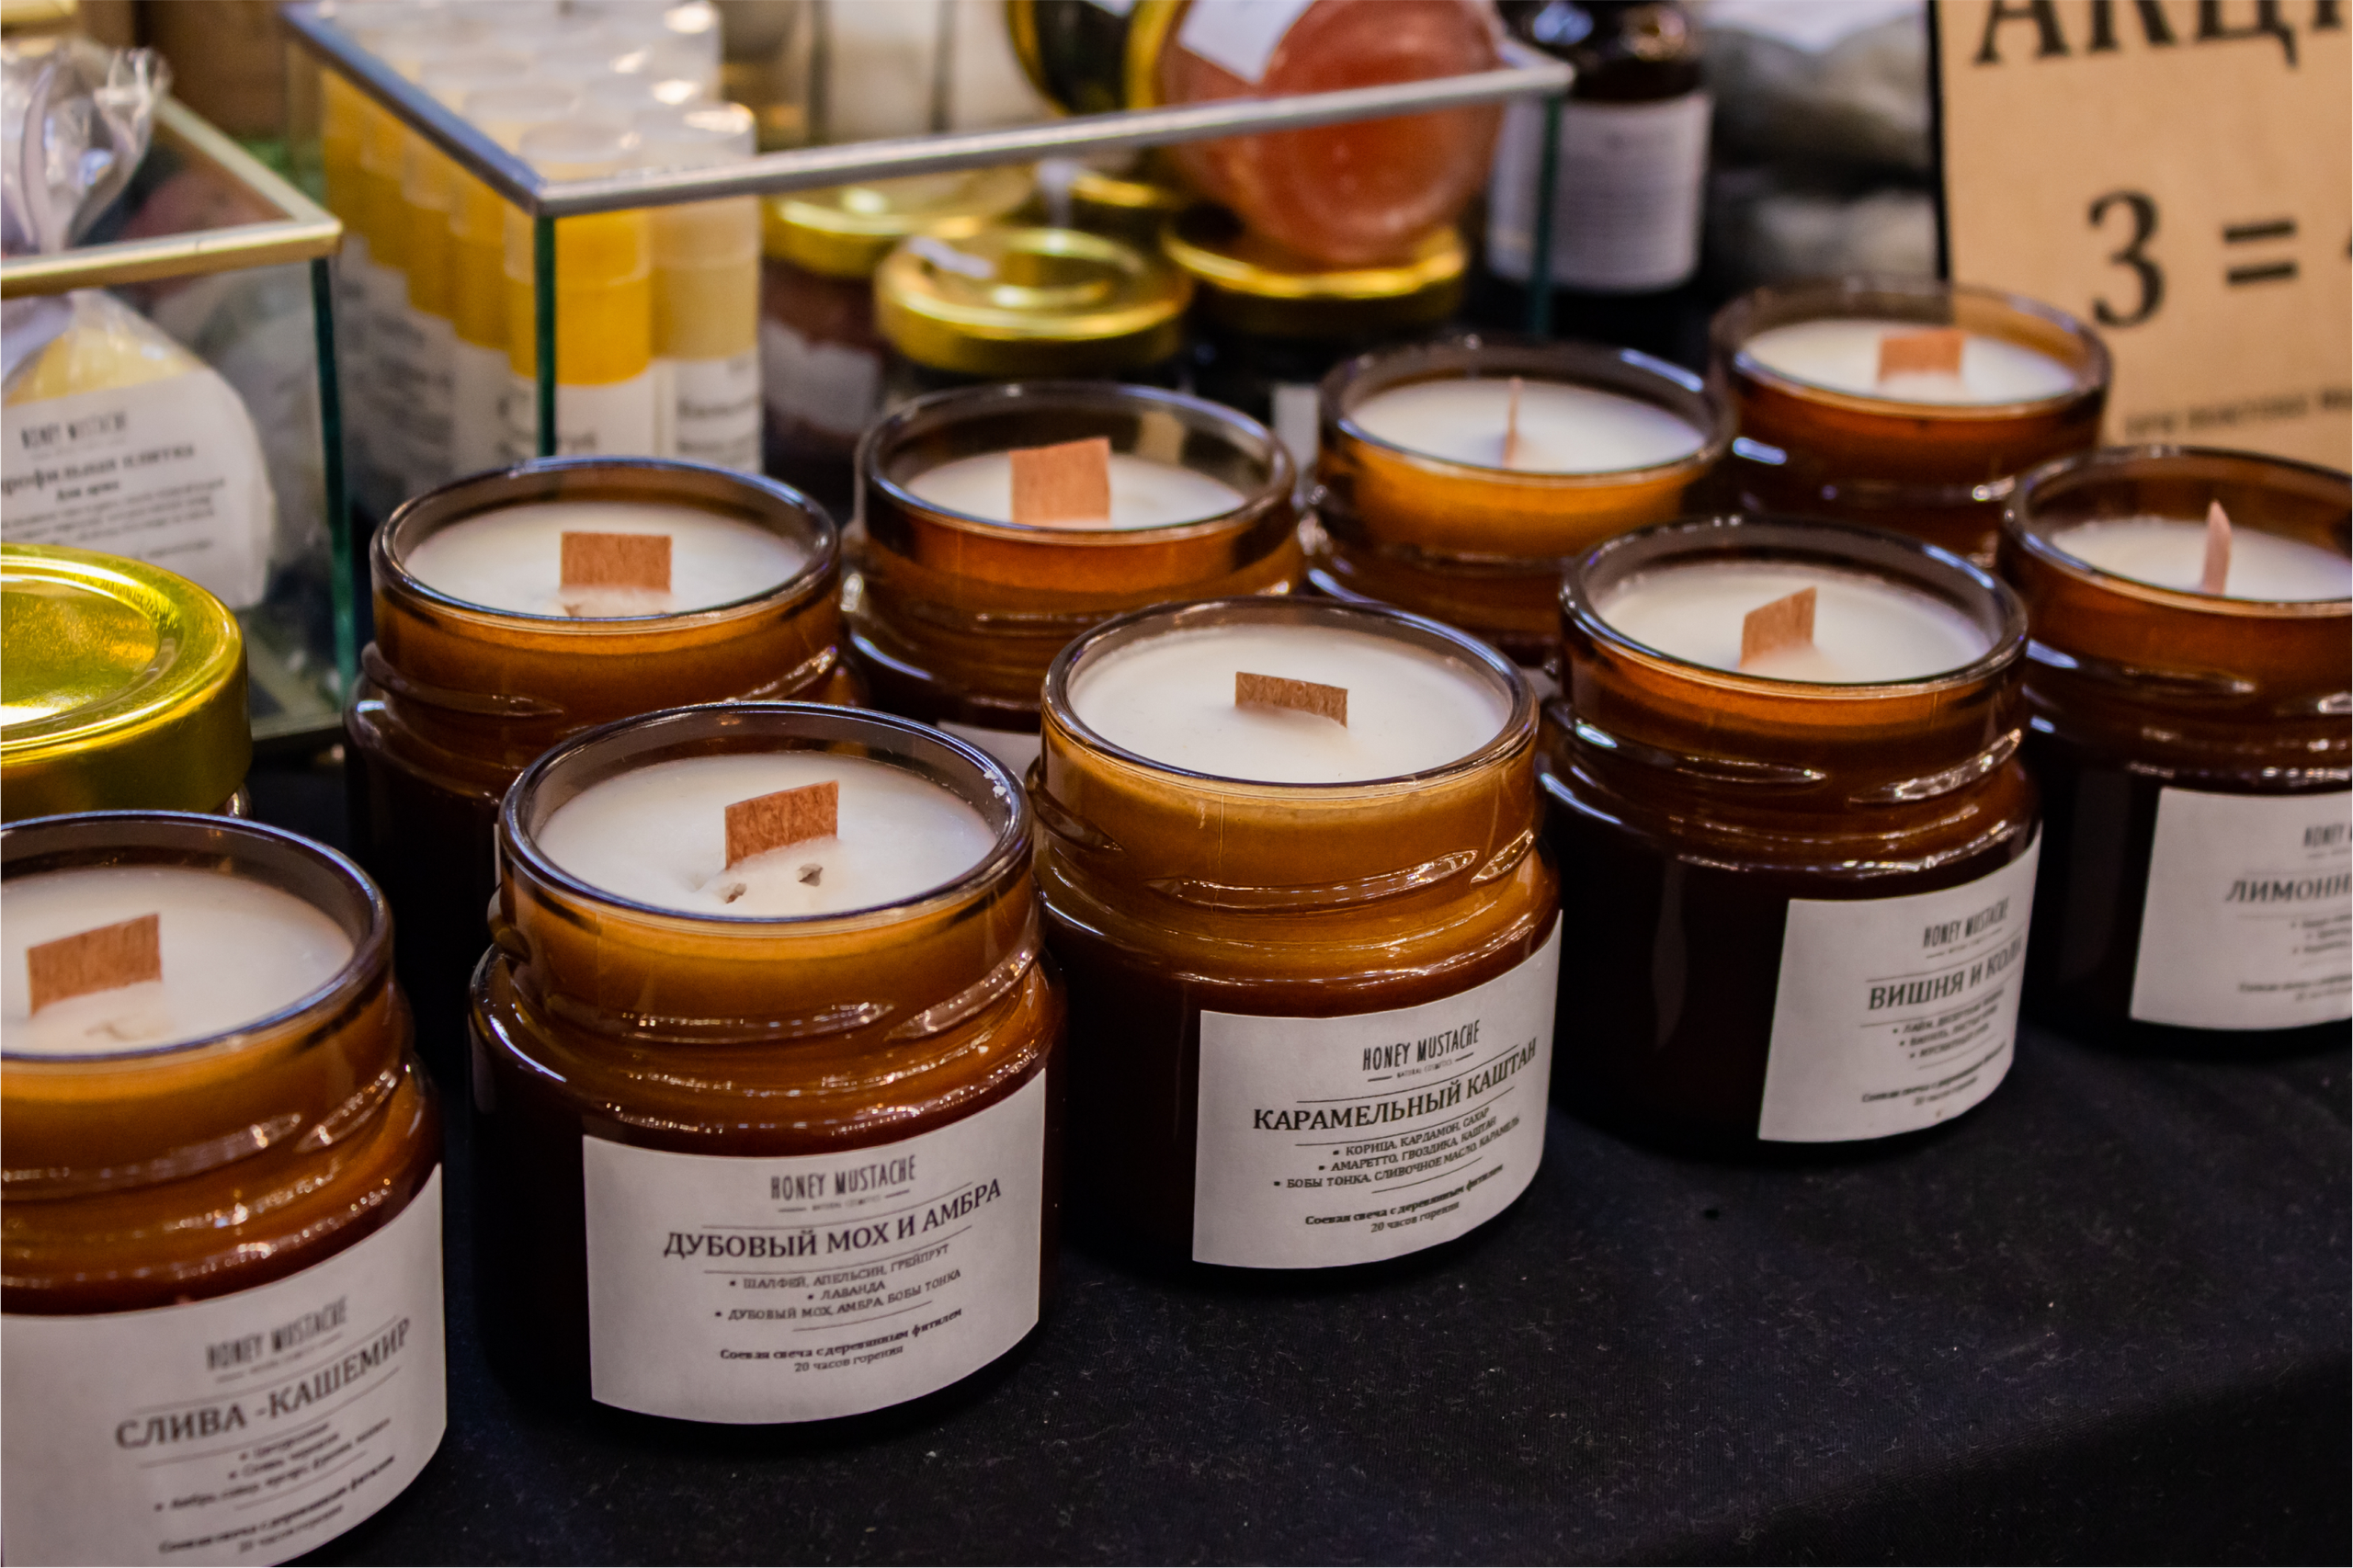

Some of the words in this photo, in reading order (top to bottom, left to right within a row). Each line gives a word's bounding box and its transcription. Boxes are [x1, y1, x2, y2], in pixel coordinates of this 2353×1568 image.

[2086, 188, 2169, 329] 3
[1869, 970, 1966, 1010] ВИШНЯ
[1970, 961, 1984, 989] И
[1362, 1042, 1411, 1071] HONEY
[1416, 1018, 1481, 1062] MUSTACHE
[1252, 1079, 1462, 1131] КАРАМЕЛЬНЫЙ
[1466, 1037, 1538, 1099] КАШТАН
[1462, 1107, 1490, 1130] САХАР
[770, 1174, 826, 1201] HONEY
[835, 1154, 916, 1196] MUSTACHE
[1287, 1176, 1324, 1188] БОБЫ
[1374, 1155, 1443, 1182] СЛИВОЧНОЕ
[664, 1229, 818, 1259] ДУБОВЫЙ
[825, 1221, 890, 1255] МОХ
[896, 1215, 915, 1239] И
[921, 1178, 1002, 1233] АМБРА
[1370, 1221, 1385, 1233] 20
[728, 1306, 797, 1321] ДУБОВЫЙ
[887, 1284, 922, 1304] БОБЫ
[925, 1267, 961, 1291] ТОНКА
[820, 1280, 885, 1301] ЛАВАНДА
[794, 1361, 810, 1373] 20
[115, 1402, 247, 1449] СЛИВА
